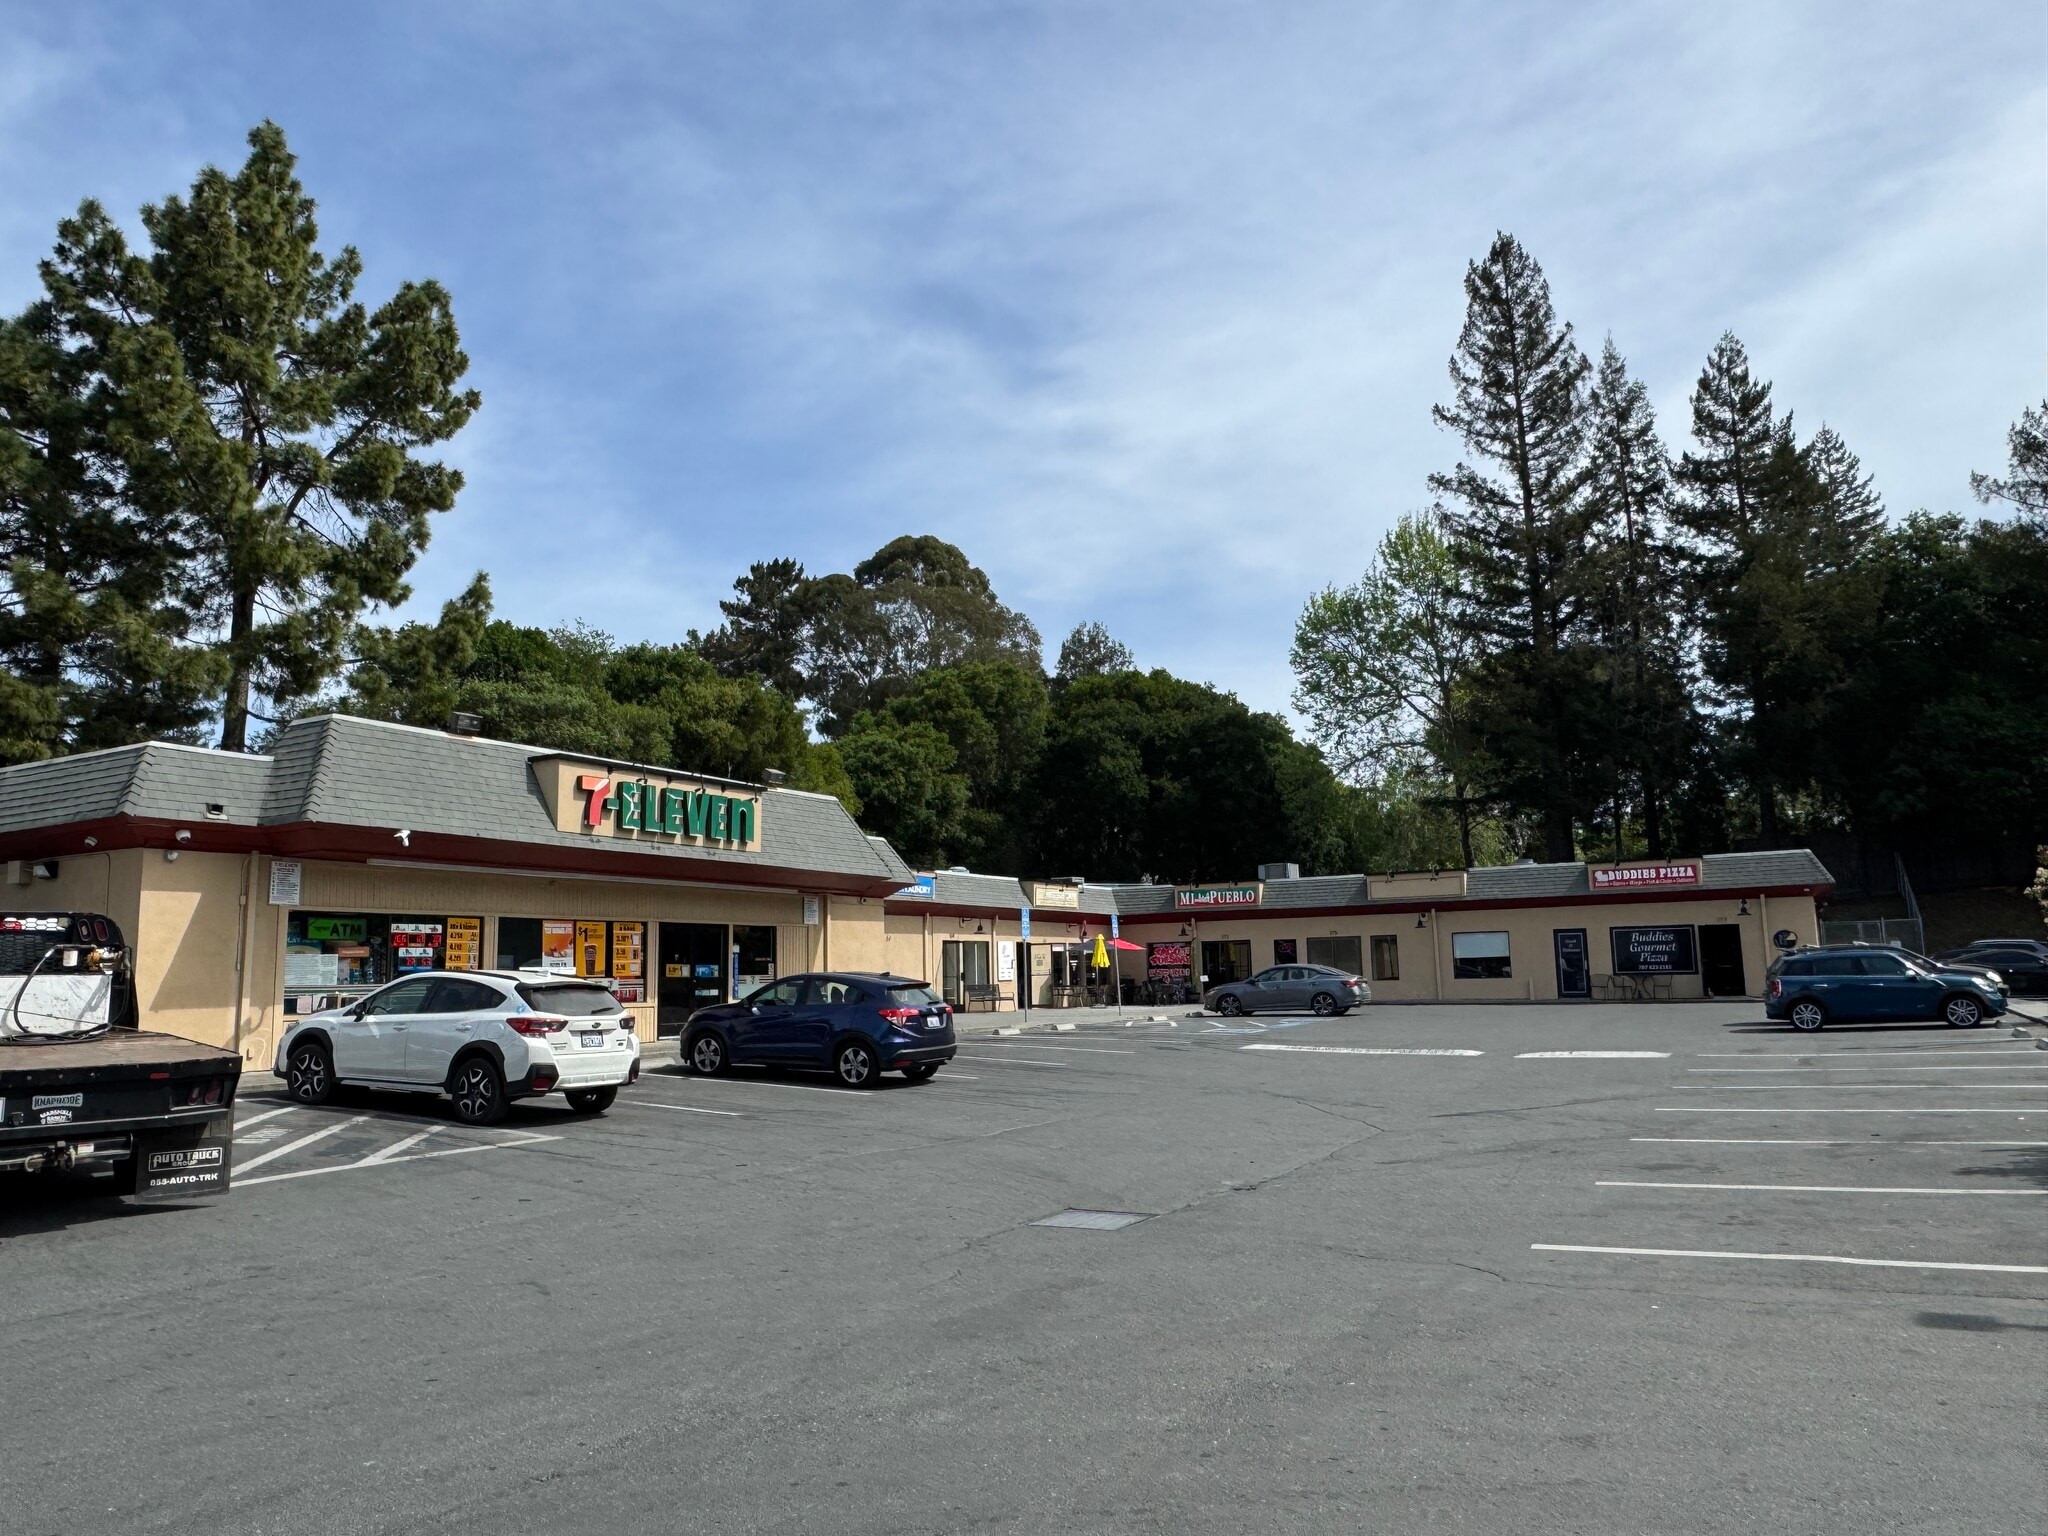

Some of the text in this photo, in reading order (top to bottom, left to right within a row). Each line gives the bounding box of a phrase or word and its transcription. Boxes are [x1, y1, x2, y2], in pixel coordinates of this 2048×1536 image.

[1607, 866, 1694, 880] BUDDIES PIZZA
[1180, 889, 1255, 905] MI PUEBLO
[329, 922, 362, 937] ATM
[578, 926, 589, 943] $1
[1631, 931, 1674, 942] Buddies
[1629, 942, 1677, 953] Gourmet
[1639, 952, 1669, 962] Pizza
[153, 1153, 184, 1168] AUTO
